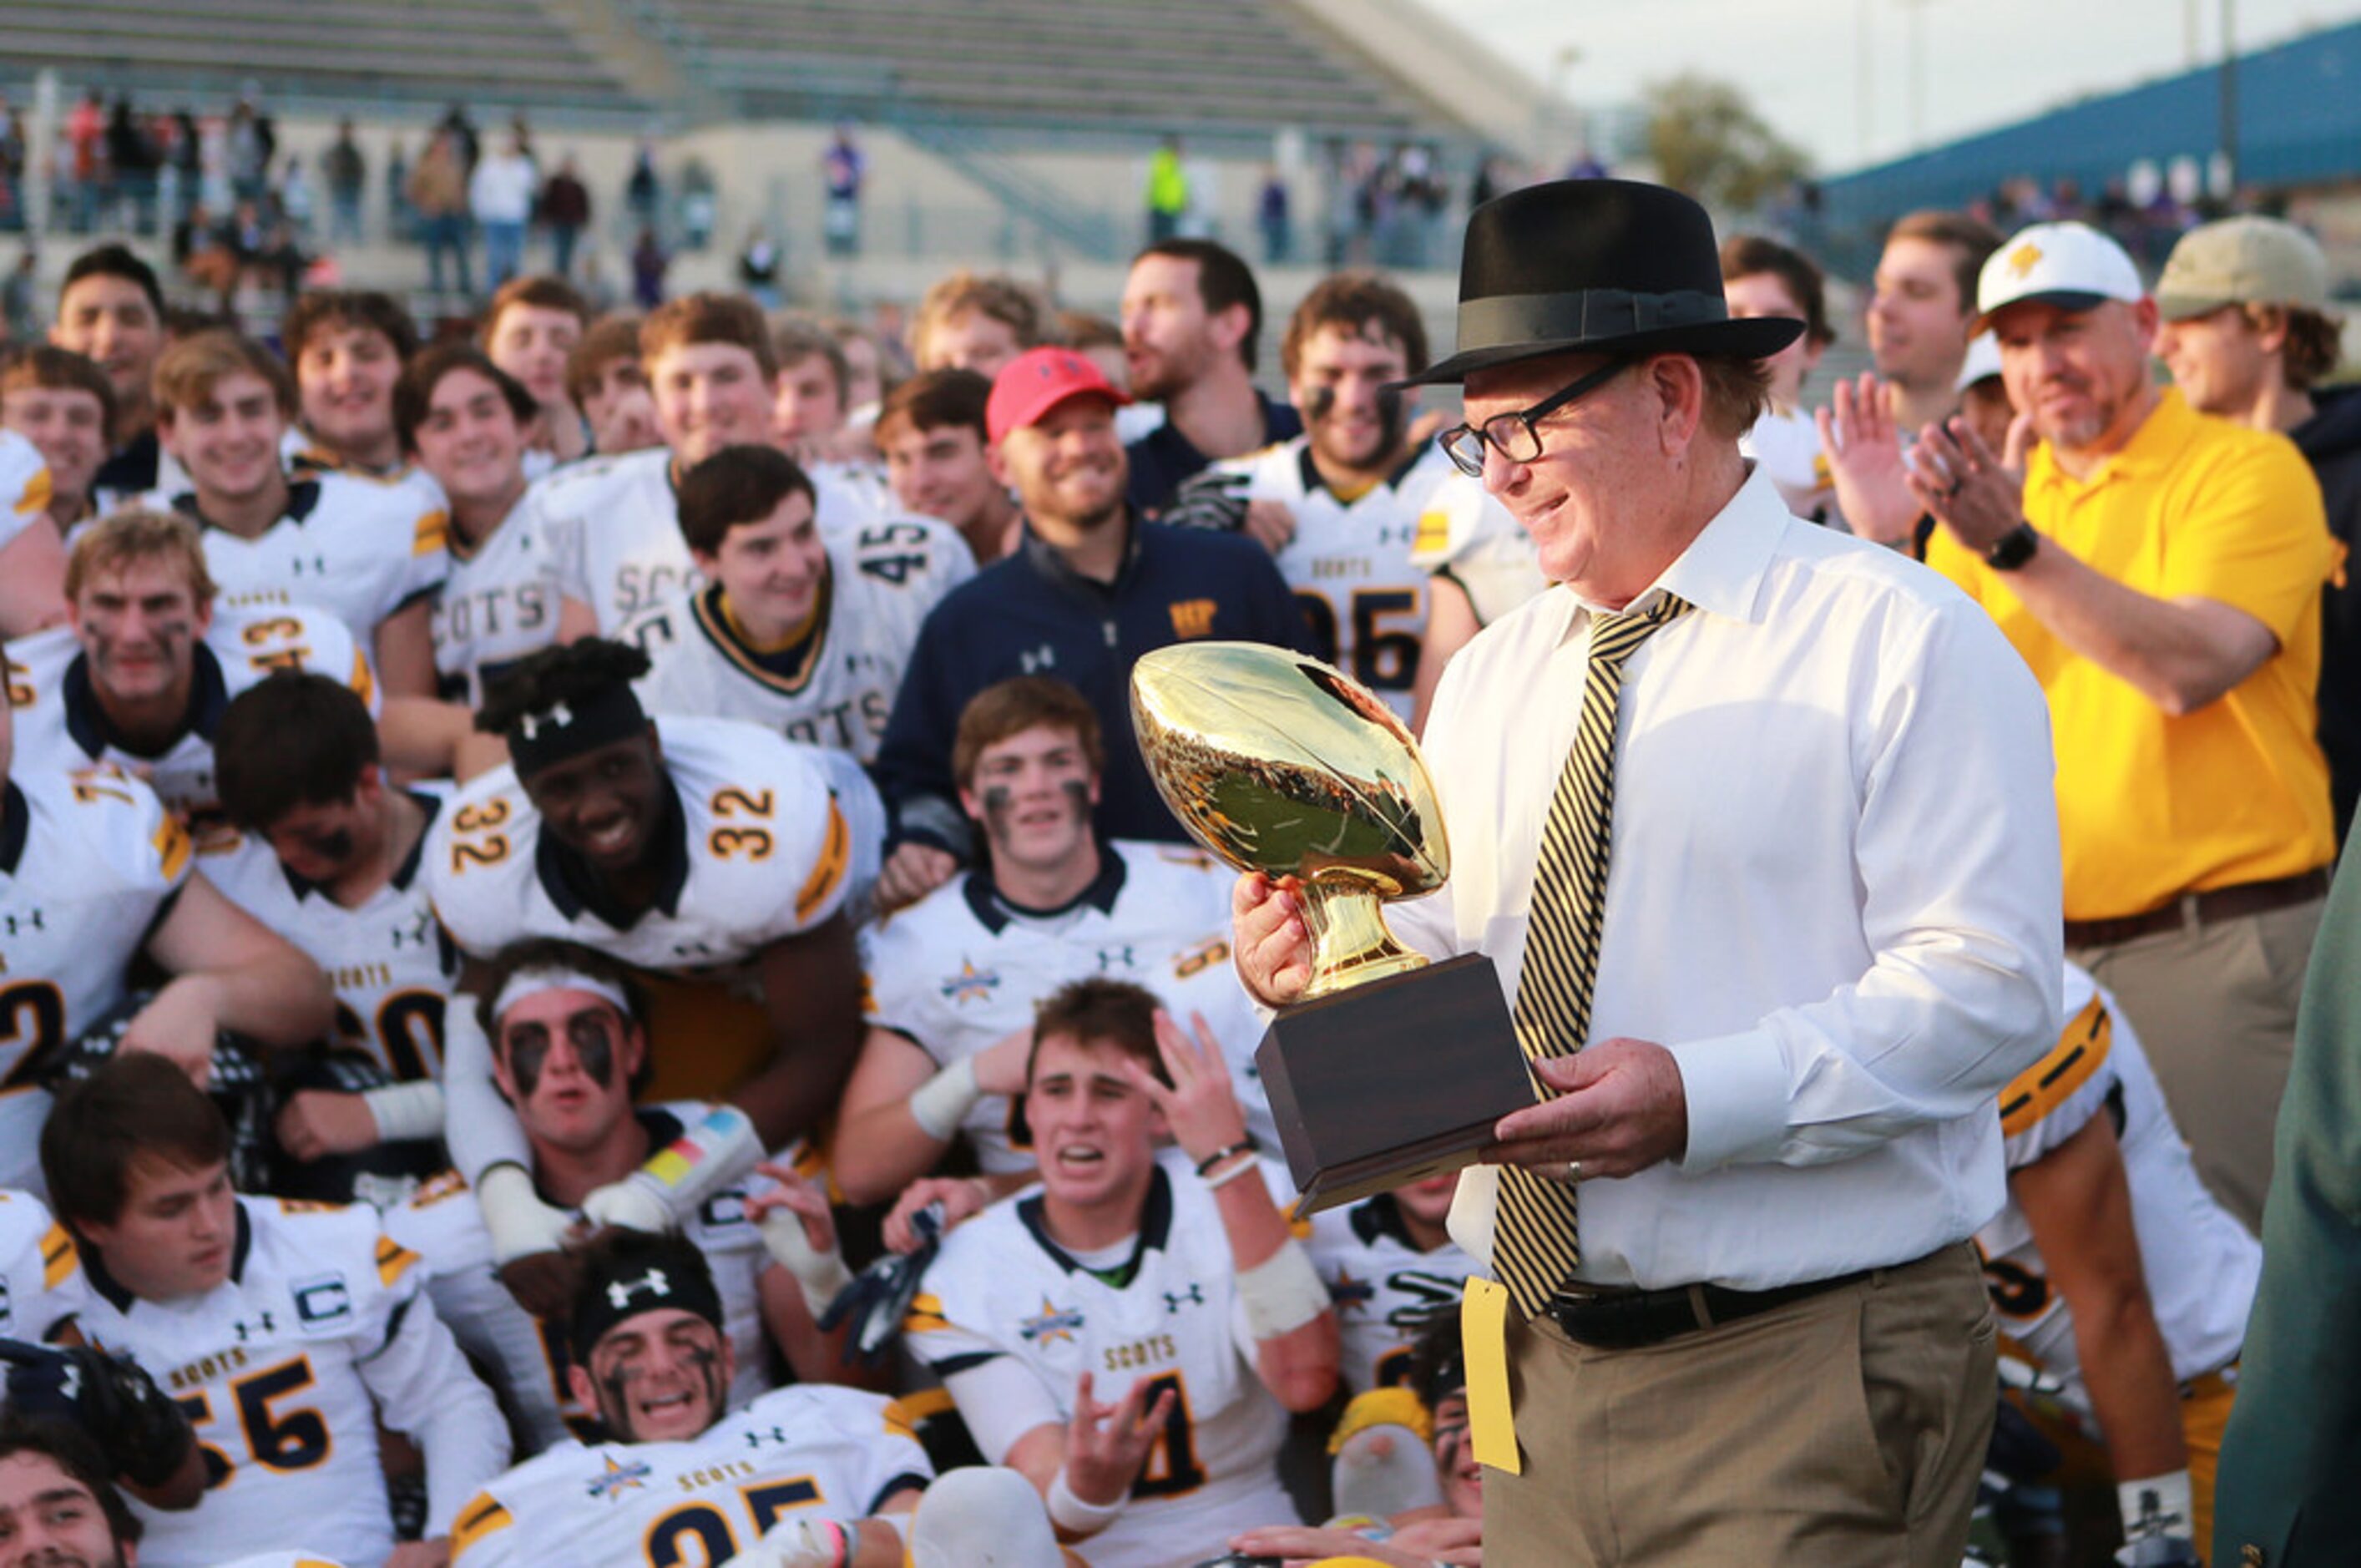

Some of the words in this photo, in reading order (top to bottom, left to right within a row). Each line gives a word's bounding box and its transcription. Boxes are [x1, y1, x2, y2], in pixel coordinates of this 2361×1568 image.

[859, 524, 928, 585] 45
[451, 797, 511, 876] 32
[710, 787, 776, 860] 32
[698, 1191, 749, 1227] C
[295, 1282, 351, 1323] C
[169, 1345, 246, 1389] SCOTS
[1104, 1333, 1177, 1372] SCOTS
[676, 1459, 756, 1493] SCOTS
